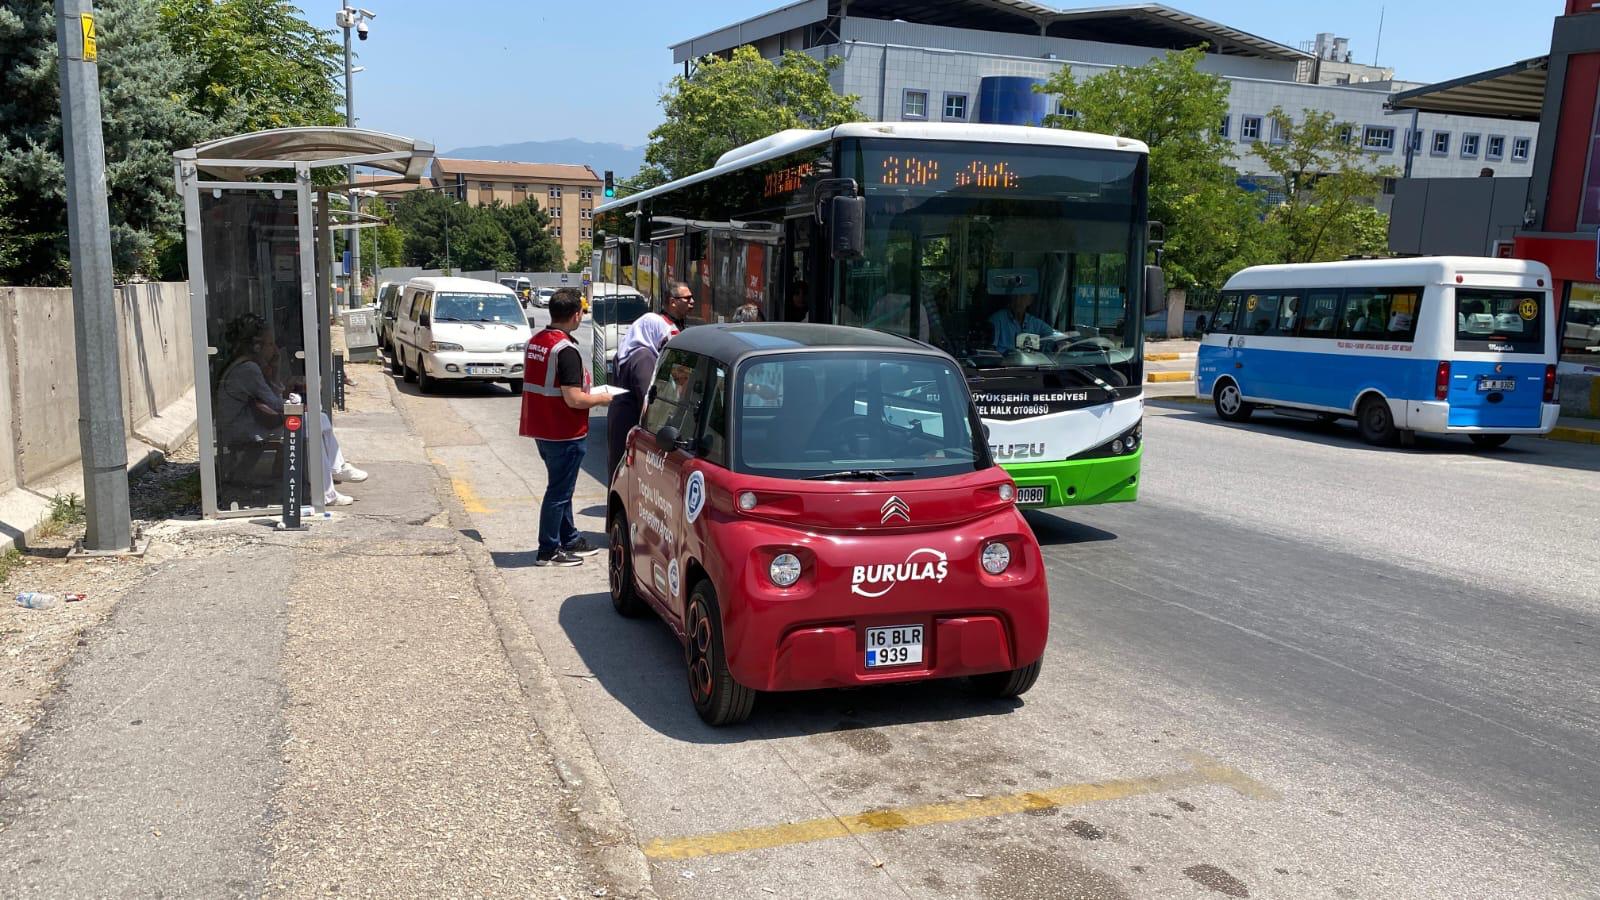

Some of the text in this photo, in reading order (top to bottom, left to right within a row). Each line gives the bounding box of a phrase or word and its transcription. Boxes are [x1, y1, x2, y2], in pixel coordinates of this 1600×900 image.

[1525, 303, 1533, 314] 14
[973, 391, 1088, 404] ÜYÜKŞEHİR BELEDİYESİ
[990, 406, 1012, 416] HALK
[1013, 404, 1049, 416] OTOBÜSÜ
[989, 443, 1045, 459] SUZU
[638, 478, 673, 520] Toplu Ulaşım
[639, 502, 673, 544] Denetim Aracı
[853, 561, 948, 583] BURULAŞ
[870, 628, 921, 646] 16 BLR
[879, 647, 908, 663] 939
